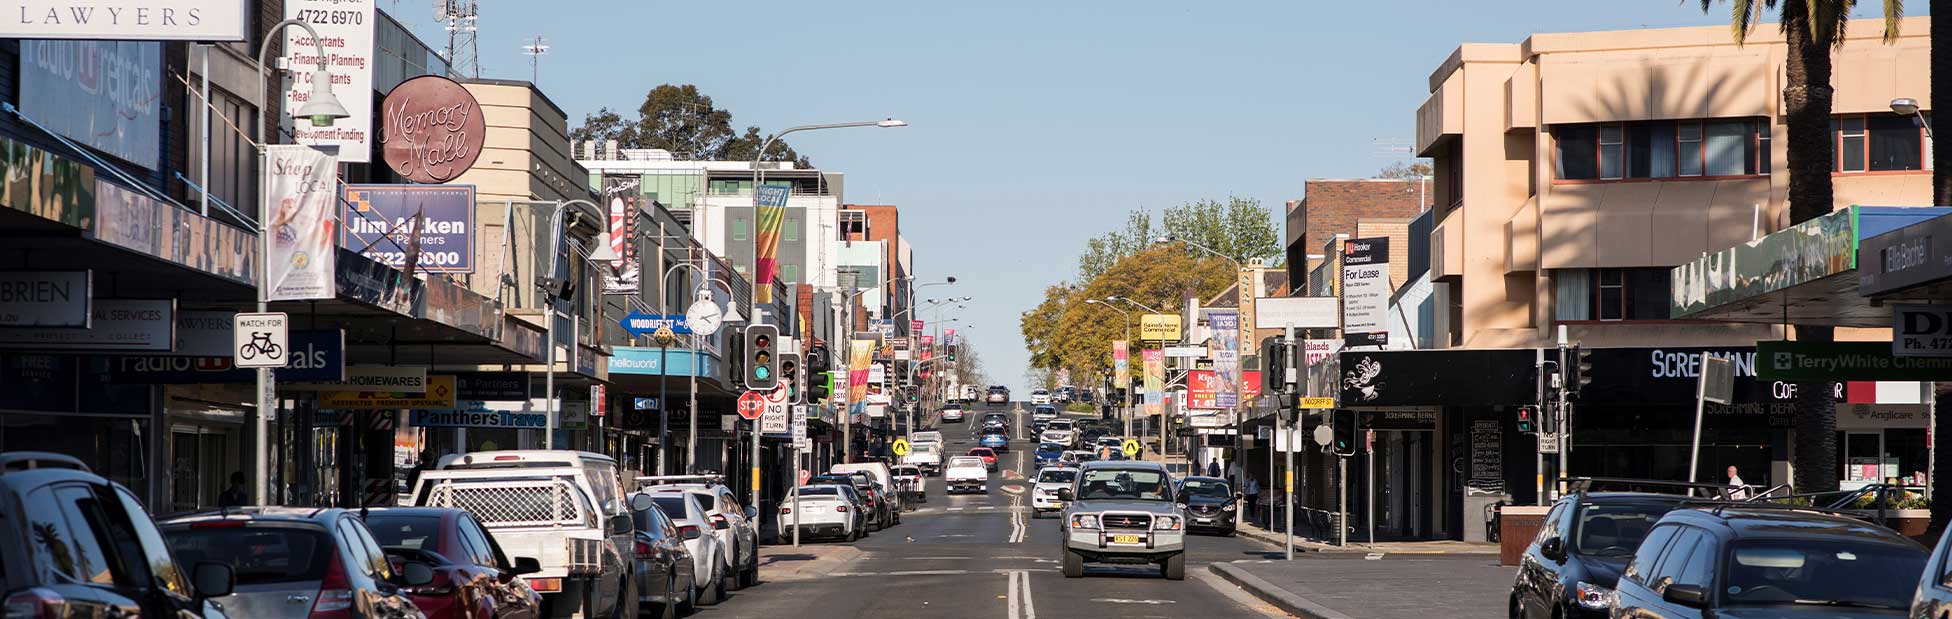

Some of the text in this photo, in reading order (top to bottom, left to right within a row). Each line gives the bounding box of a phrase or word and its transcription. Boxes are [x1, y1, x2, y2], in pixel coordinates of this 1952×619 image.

[20, 7, 200, 26] LAWYERS
[297, 10, 363, 25] 4722 6970
[295, 36, 345, 48] Accontants
[294, 53, 365, 69] Financal Planning
[377, 98, 473, 144] Memory
[337, 126, 364, 143] Funding
[400, 131, 469, 181] Mall
[273, 157, 313, 181] Shop
[296, 180, 332, 194] LOCAL
[350, 217, 465, 234] Jim Aiken
[396, 234, 445, 245] Paners
[1345, 269, 1380, 280] For Lease
[111, 310, 161, 321] SERVICES
[240, 319, 282, 327] WATCH FOR
[667, 319, 675, 329] ST
[1904, 338, 1927, 349] Ph.
[119, 356, 190, 373] radio
[1794, 354, 1891, 371] TerryWhite
[349, 375, 421, 387] HOMEWARES
[741, 400, 763, 410] STOP
[769, 404, 782, 413] NO
[416, 408, 547, 427] PanthersTrave
[1870, 411, 1913, 421] Anglicare
